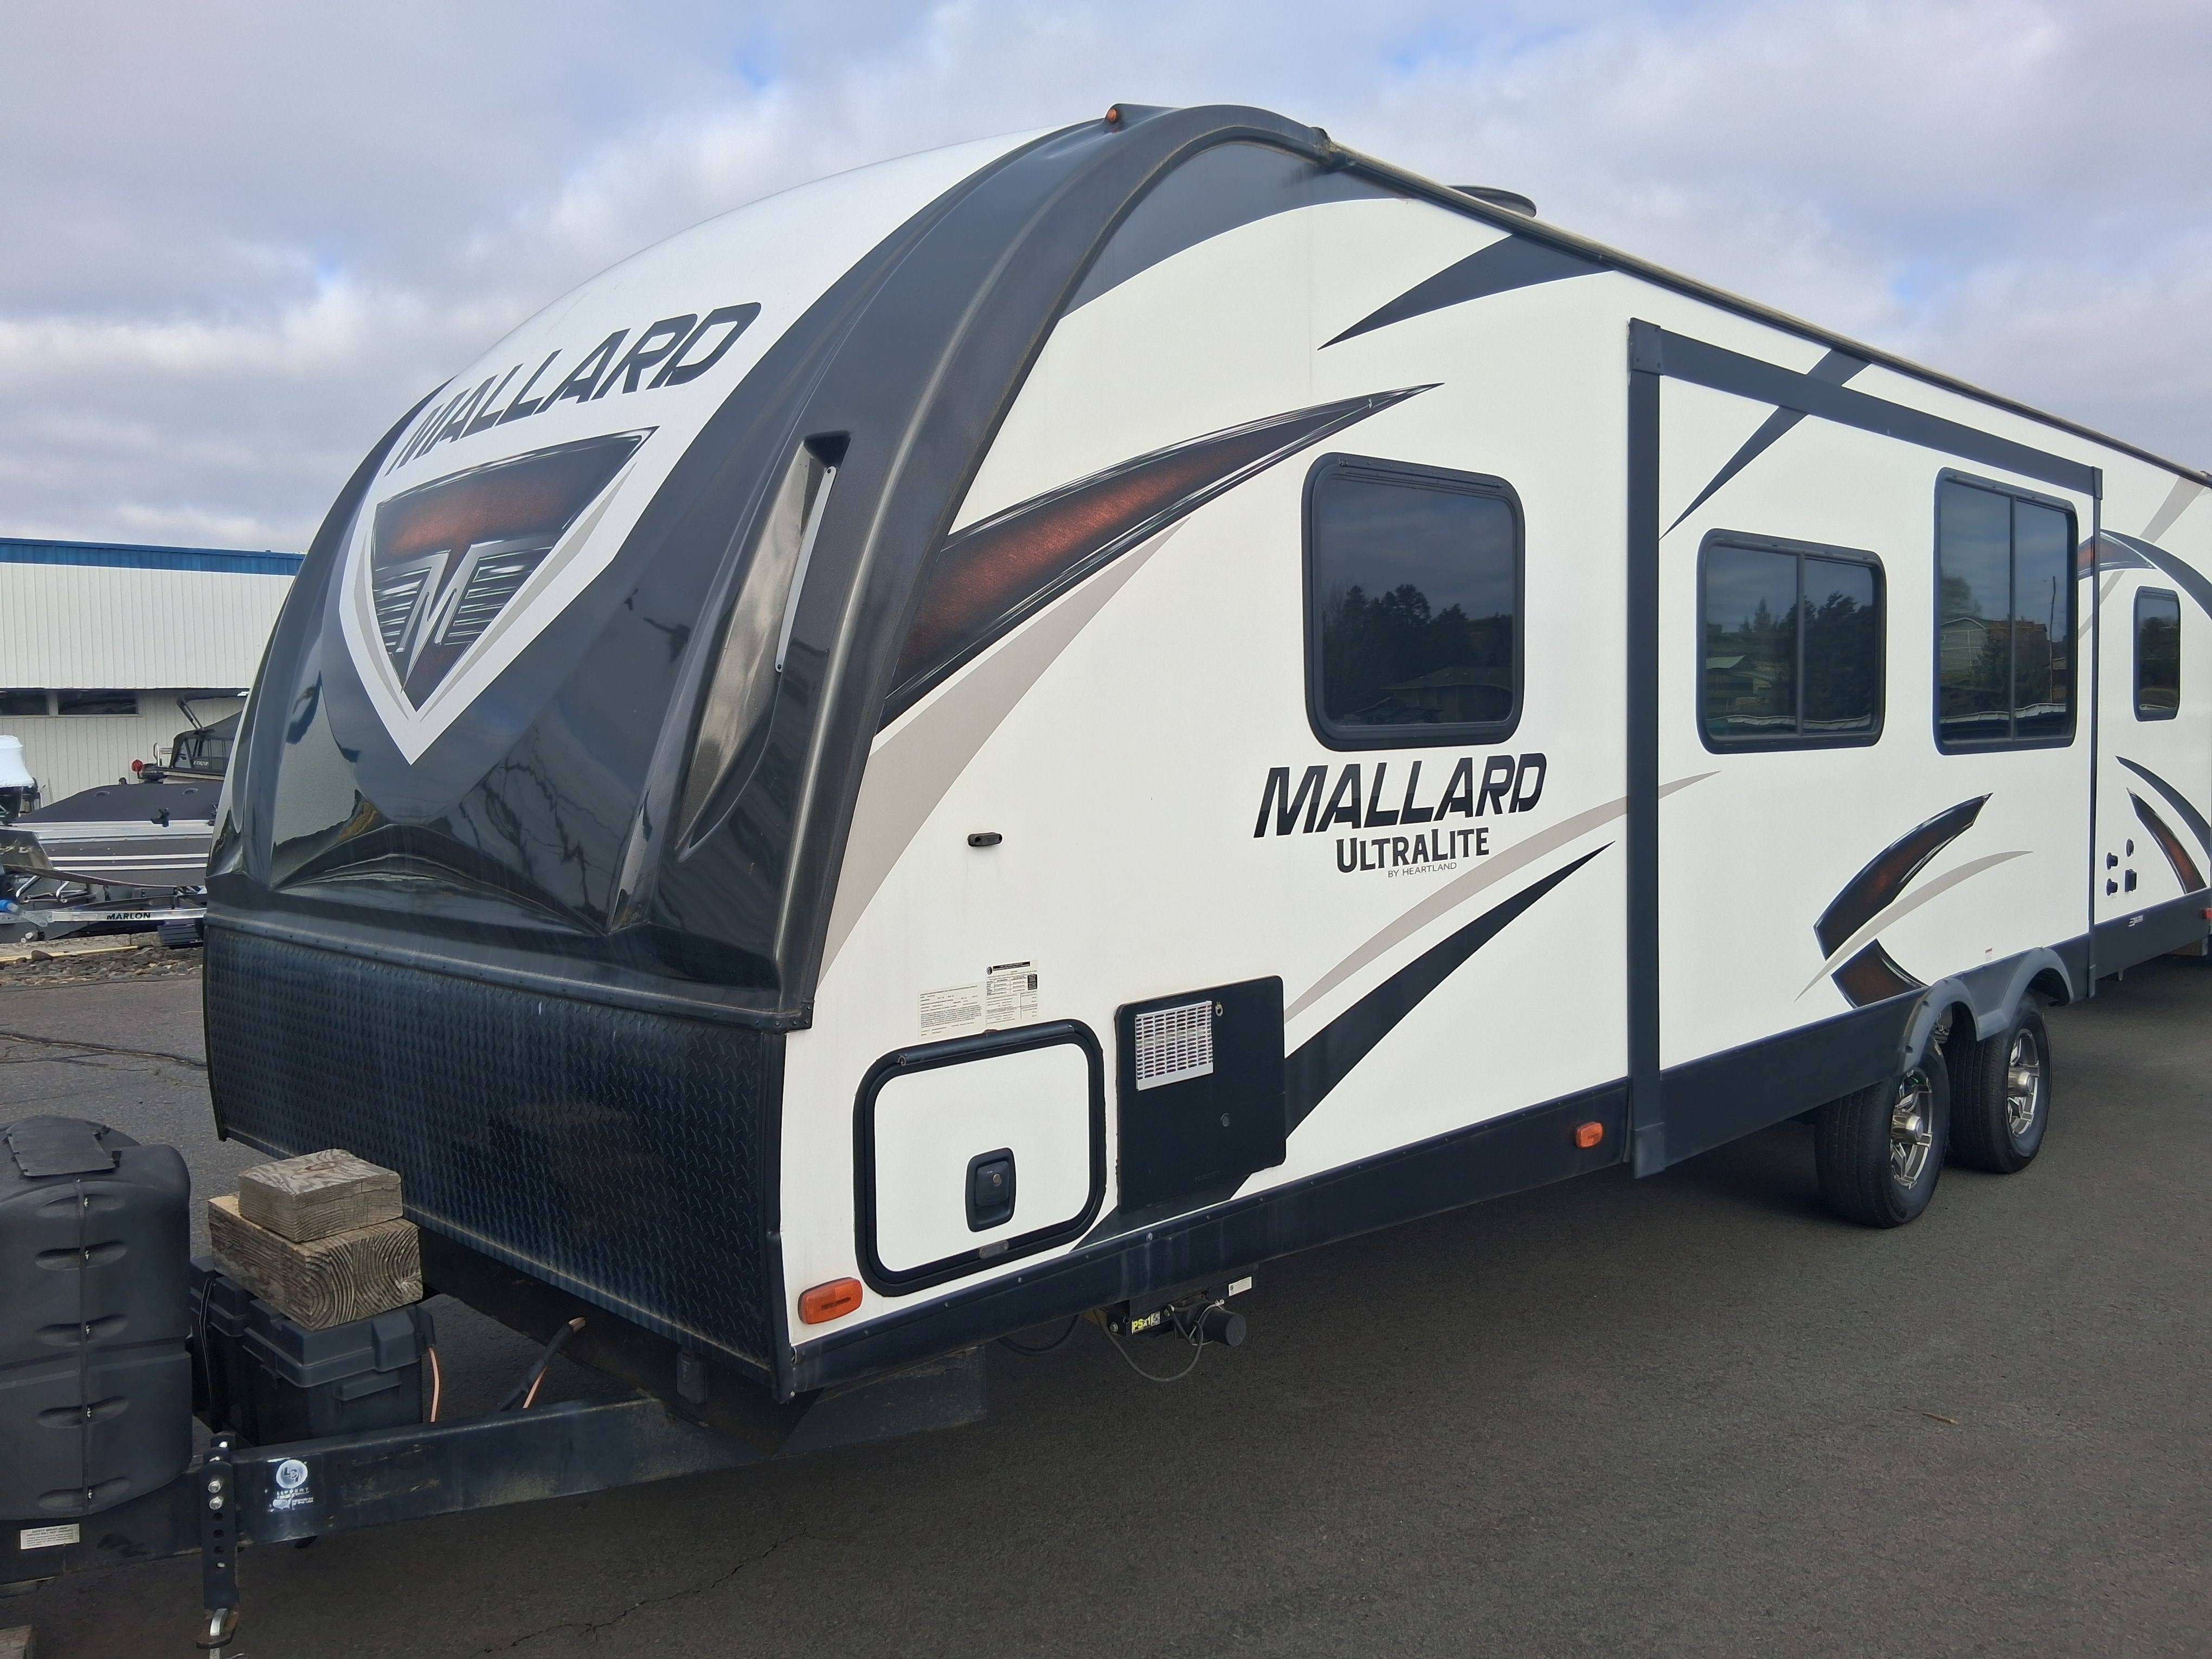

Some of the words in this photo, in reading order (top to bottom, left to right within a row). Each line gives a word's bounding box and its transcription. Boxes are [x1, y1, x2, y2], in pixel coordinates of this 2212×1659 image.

[385, 301, 762, 477] MALLARD
[1253, 753, 1547, 838] MALLARD
[1388, 869, 1400, 878] BY
[1401, 861, 1457, 877] HEARTLAND
[106, 912, 151, 920] MARLON
